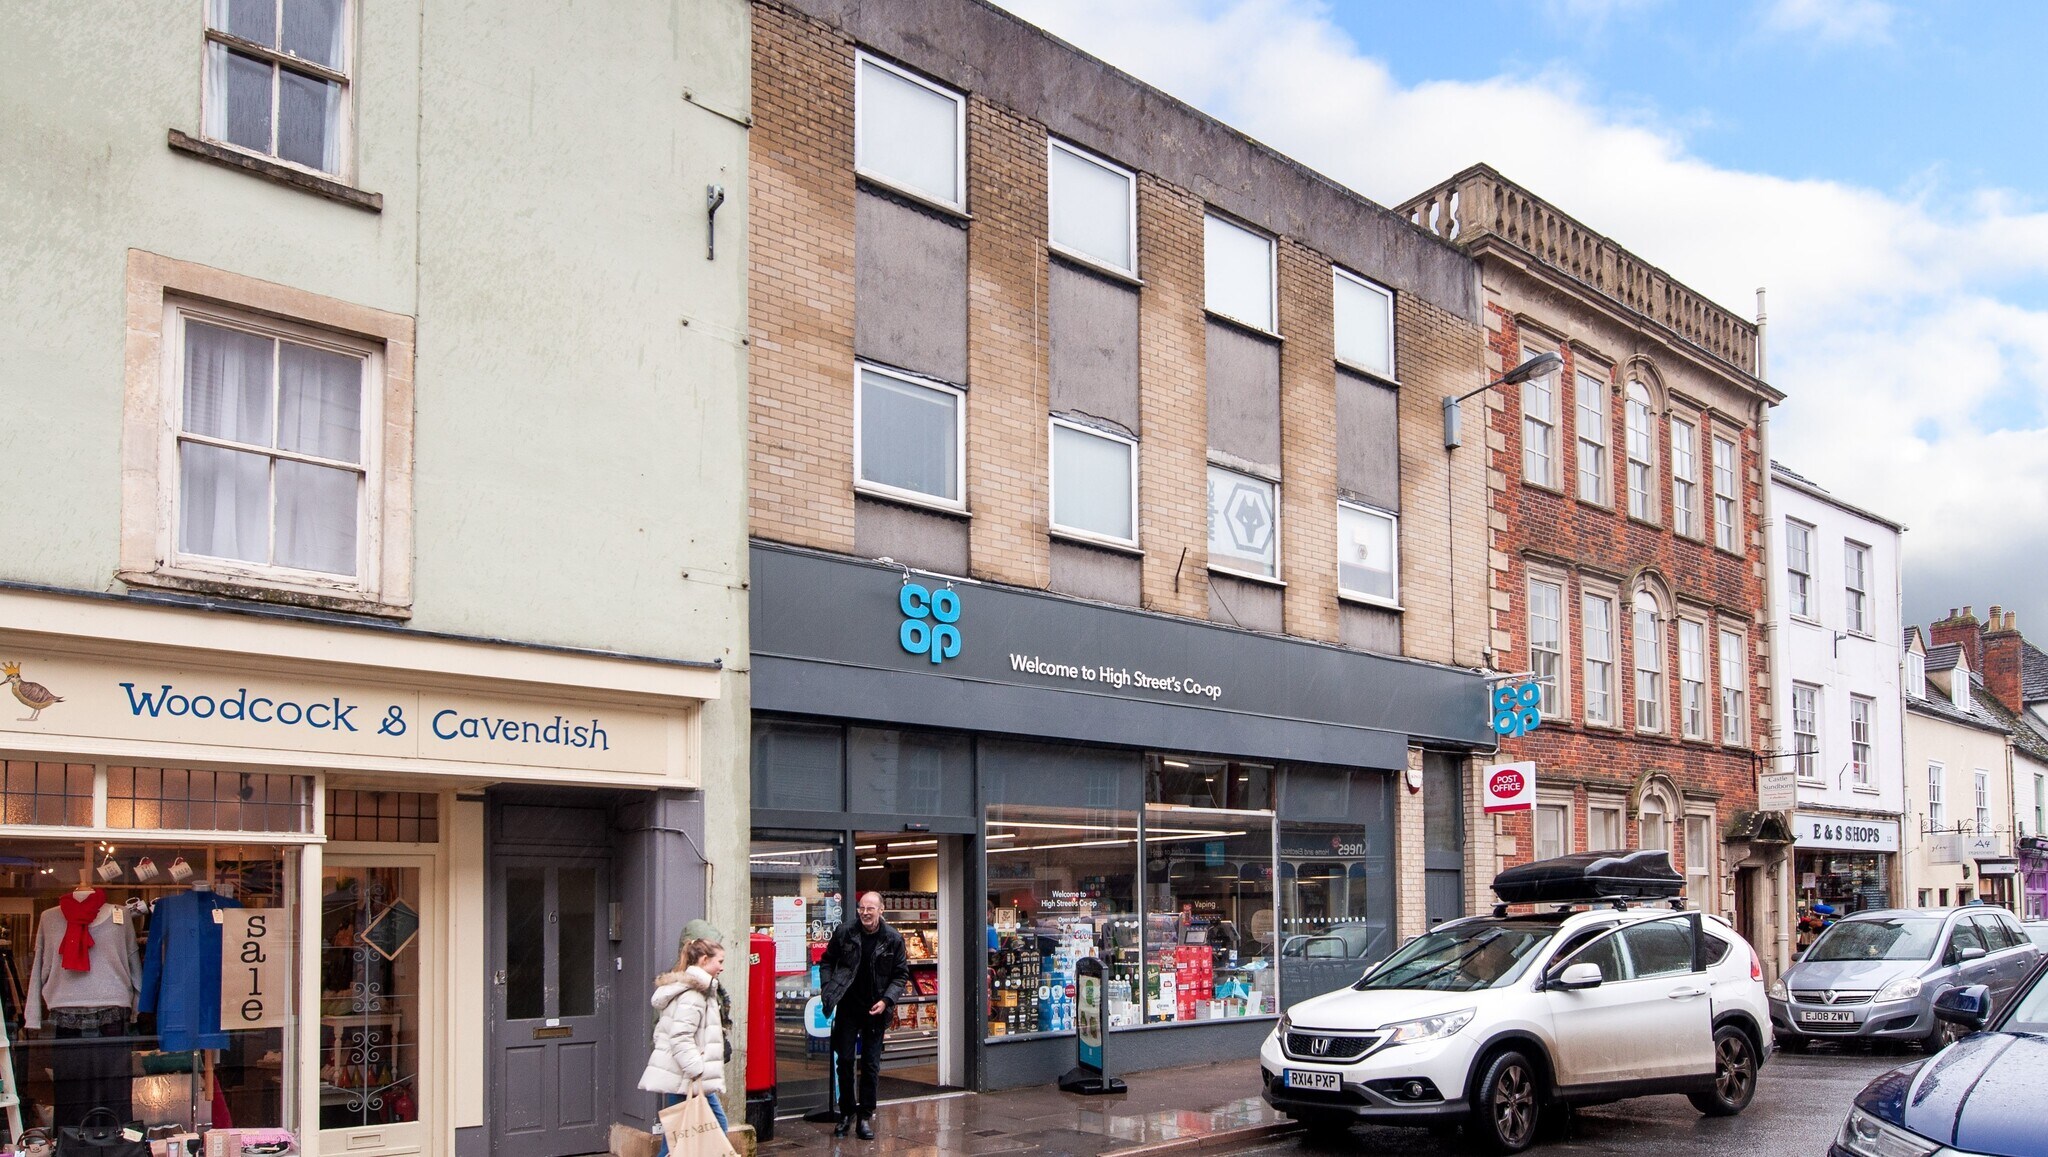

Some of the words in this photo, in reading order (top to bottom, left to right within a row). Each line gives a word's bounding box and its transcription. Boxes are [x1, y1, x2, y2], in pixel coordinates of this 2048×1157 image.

[1009, 653, 1078, 679] Welcome
[1081, 665, 1096, 681] to
[1099, 666, 1131, 688] High
[1133, 671, 1181, 692] Street's
[1183, 678, 1222, 700] Co-op
[119, 683, 358, 731] Woodcock
[377, 704, 407, 737] &
[432, 709, 610, 751] Cavendish
[1497, 775, 1517, 784] POST
[1492, 783, 1521, 793] OFFICE
[1813, 823, 1821, 839] E
[1824, 824, 1833, 840] &
[1836, 825, 1842, 840] S
[1845, 826, 1879, 843] SHOPS
[1974, 840, 1990, 848] A4
[1052, 890, 1079, 898] Welcome
[1041, 900, 1055, 909] High
[1079, 900, 1097, 908] Co-op
[1194, 900, 1216, 910] Vaping
[548, 911, 557, 924] 6
[240, 915, 267, 1021] sale
[1805, 1012, 1828, 1021] EJ08
[1831, 1012, 1849, 1021] ZWV
[1292, 1072, 1313, 1086] RX14
[1316, 1075, 1335, 1088] PXP
